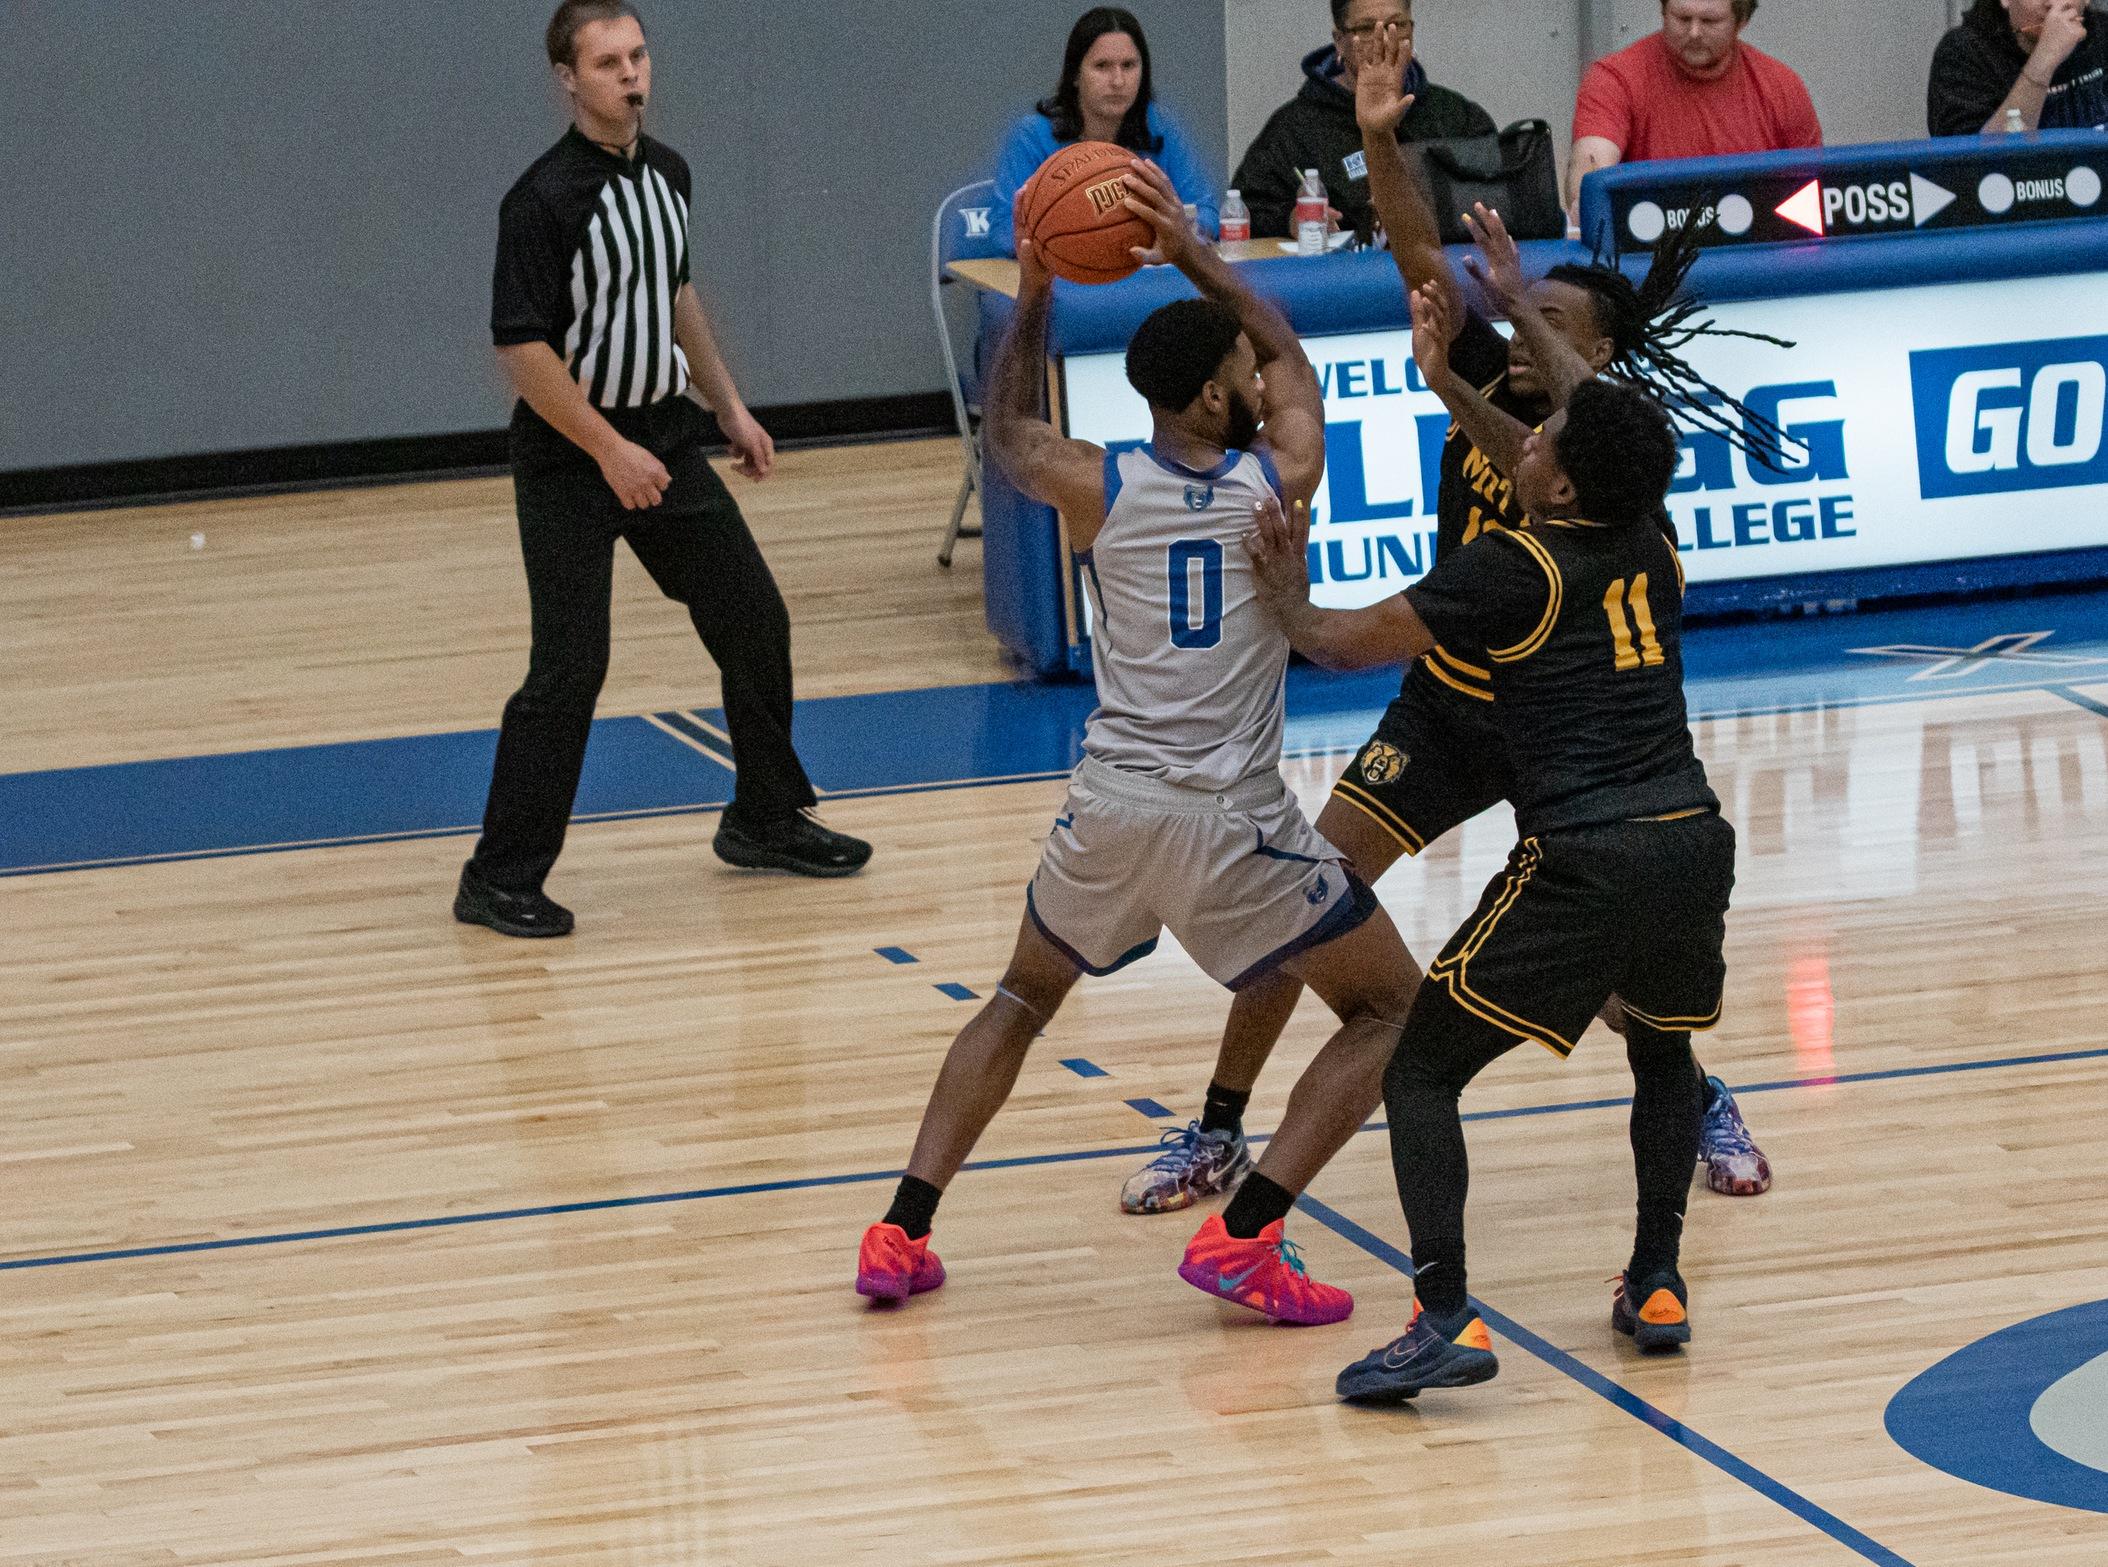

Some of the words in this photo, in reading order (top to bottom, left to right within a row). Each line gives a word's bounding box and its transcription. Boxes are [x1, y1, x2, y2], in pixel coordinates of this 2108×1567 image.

[1667, 206, 1714, 229] BOUS
[1823, 181, 1910, 226] POSS
[2015, 178, 2065, 201] BONUS
[1945, 361, 2106, 474] GO
[1167, 537, 1225, 651] 0
[1603, 571, 1665, 672] 11
